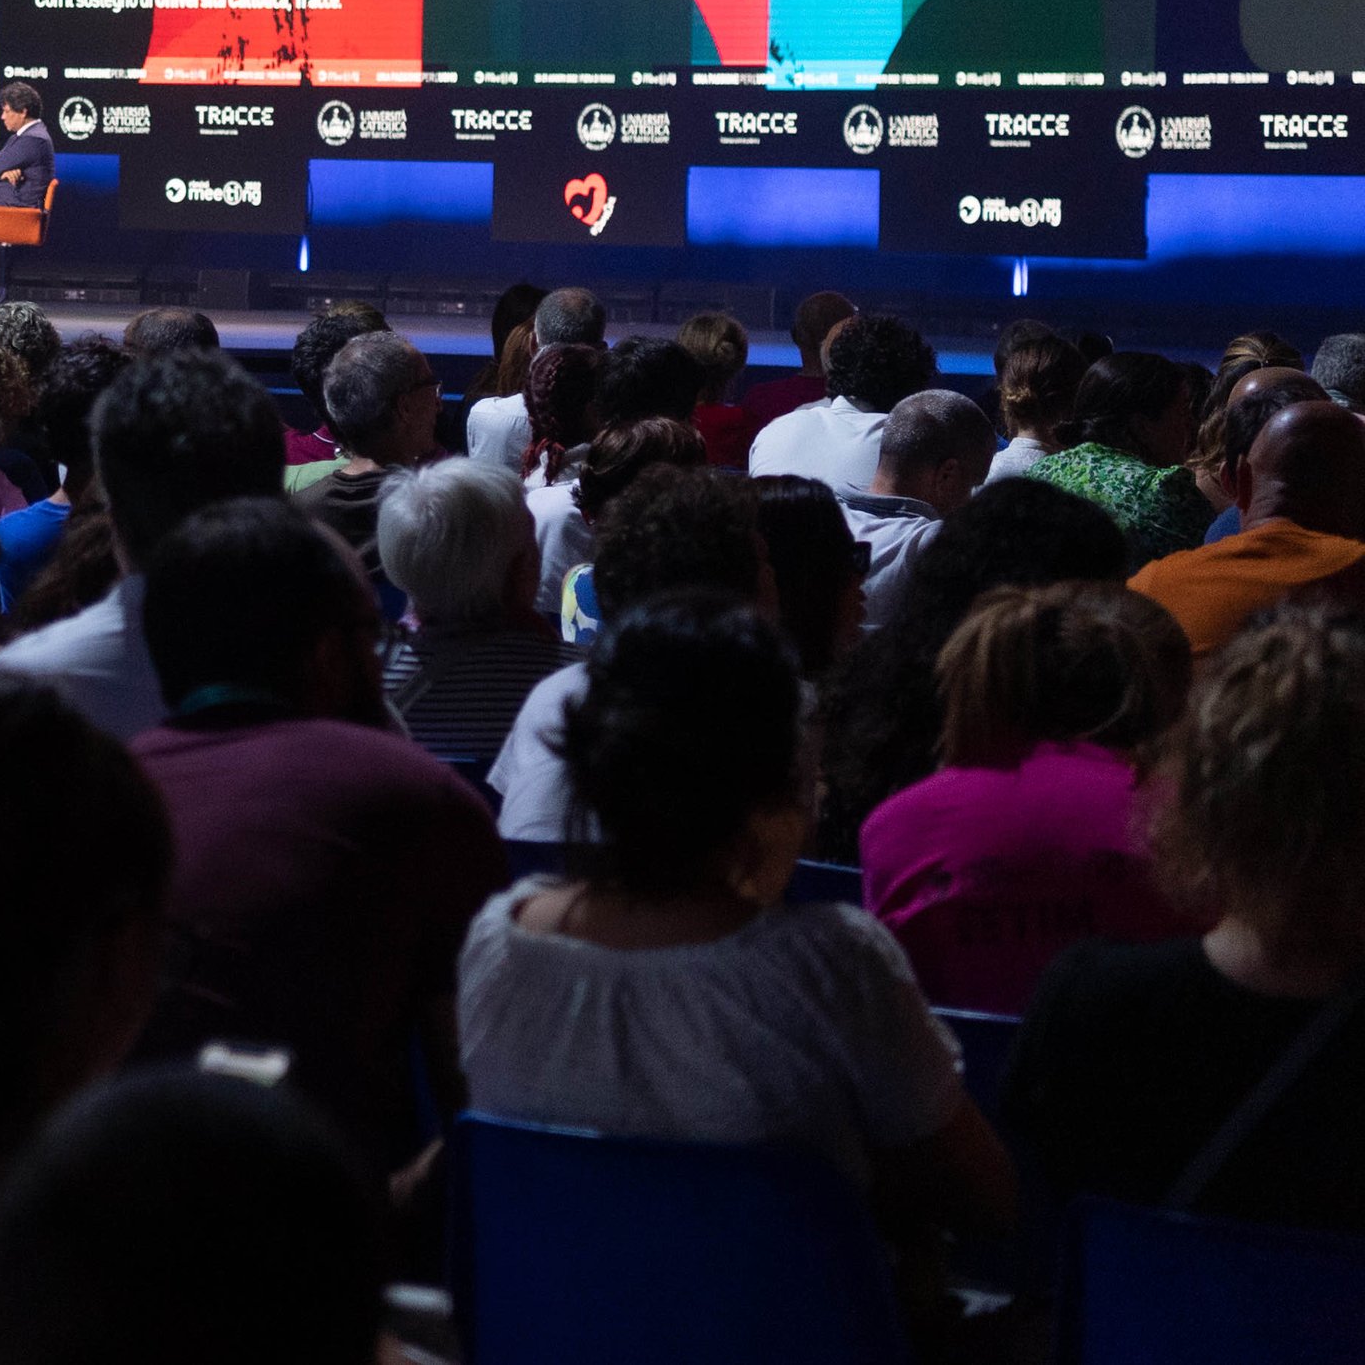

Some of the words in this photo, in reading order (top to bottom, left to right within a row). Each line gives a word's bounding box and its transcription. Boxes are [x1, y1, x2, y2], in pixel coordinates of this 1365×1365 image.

[195, 105, 274, 126] TRACCE
[451, 109, 532, 131] TRACCE
[715, 112, 797, 134] TRACCE
[985, 113, 1069, 136] TRACCE
[1259, 114, 1348, 137] TRACCE
[188, 183, 262, 206] meeting
